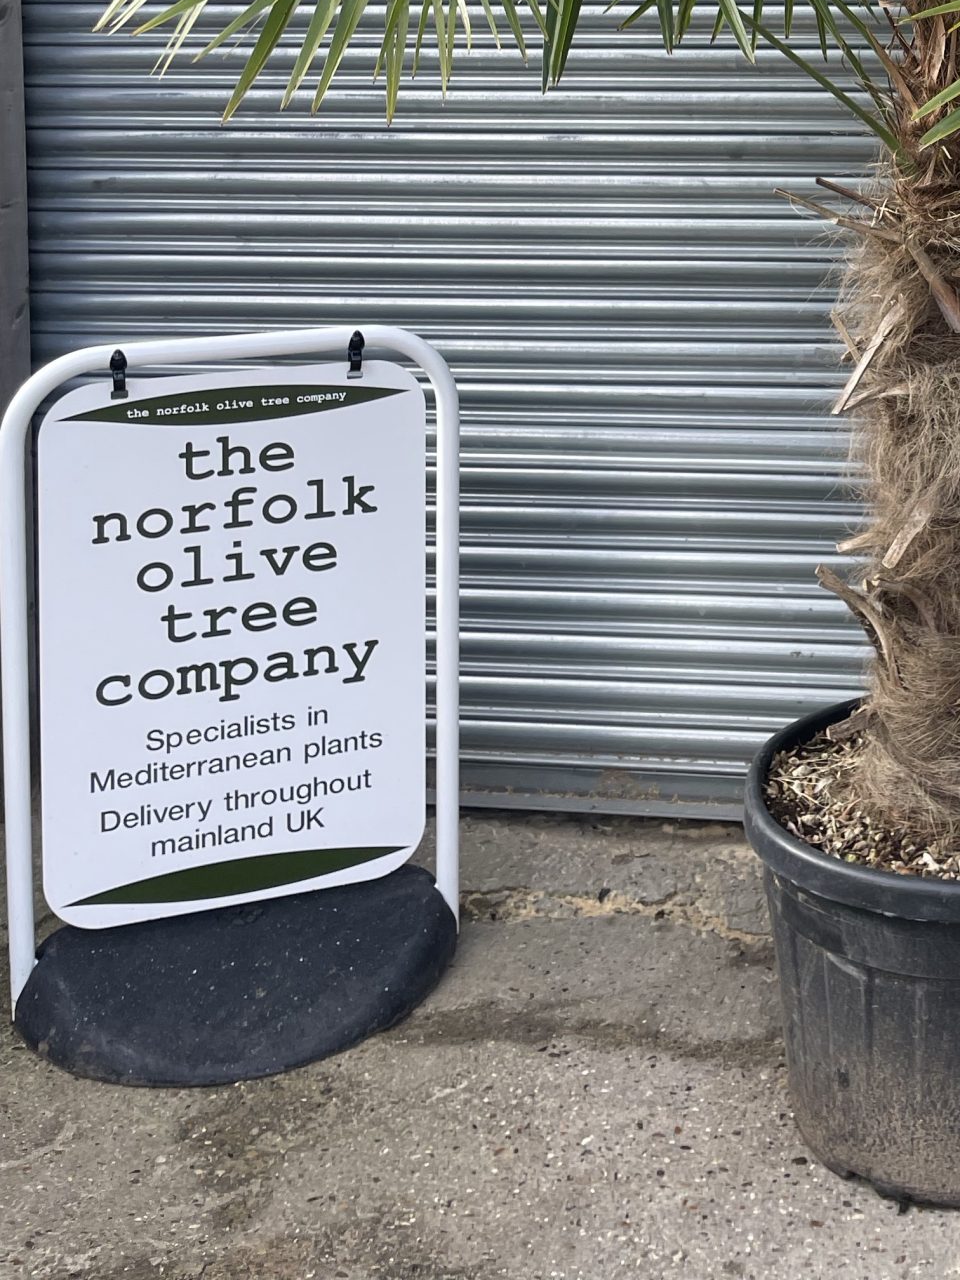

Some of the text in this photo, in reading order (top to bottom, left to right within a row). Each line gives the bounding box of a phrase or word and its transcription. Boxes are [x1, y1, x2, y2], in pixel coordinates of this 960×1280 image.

[127, 391, 347, 418] the norfolk olive tree company
[178, 435, 295, 481] the
[91, 475, 378, 544] norfolk
[136, 540, 338, 593] olive
[160, 596, 318, 643] tree
[95, 639, 379, 707] company
[146, 706, 328, 754] Specialists in
[90, 730, 383, 794] Mediterranean plants
[100, 769, 372, 833] Delivery throughout
[151, 807, 325, 857] mainland UK
